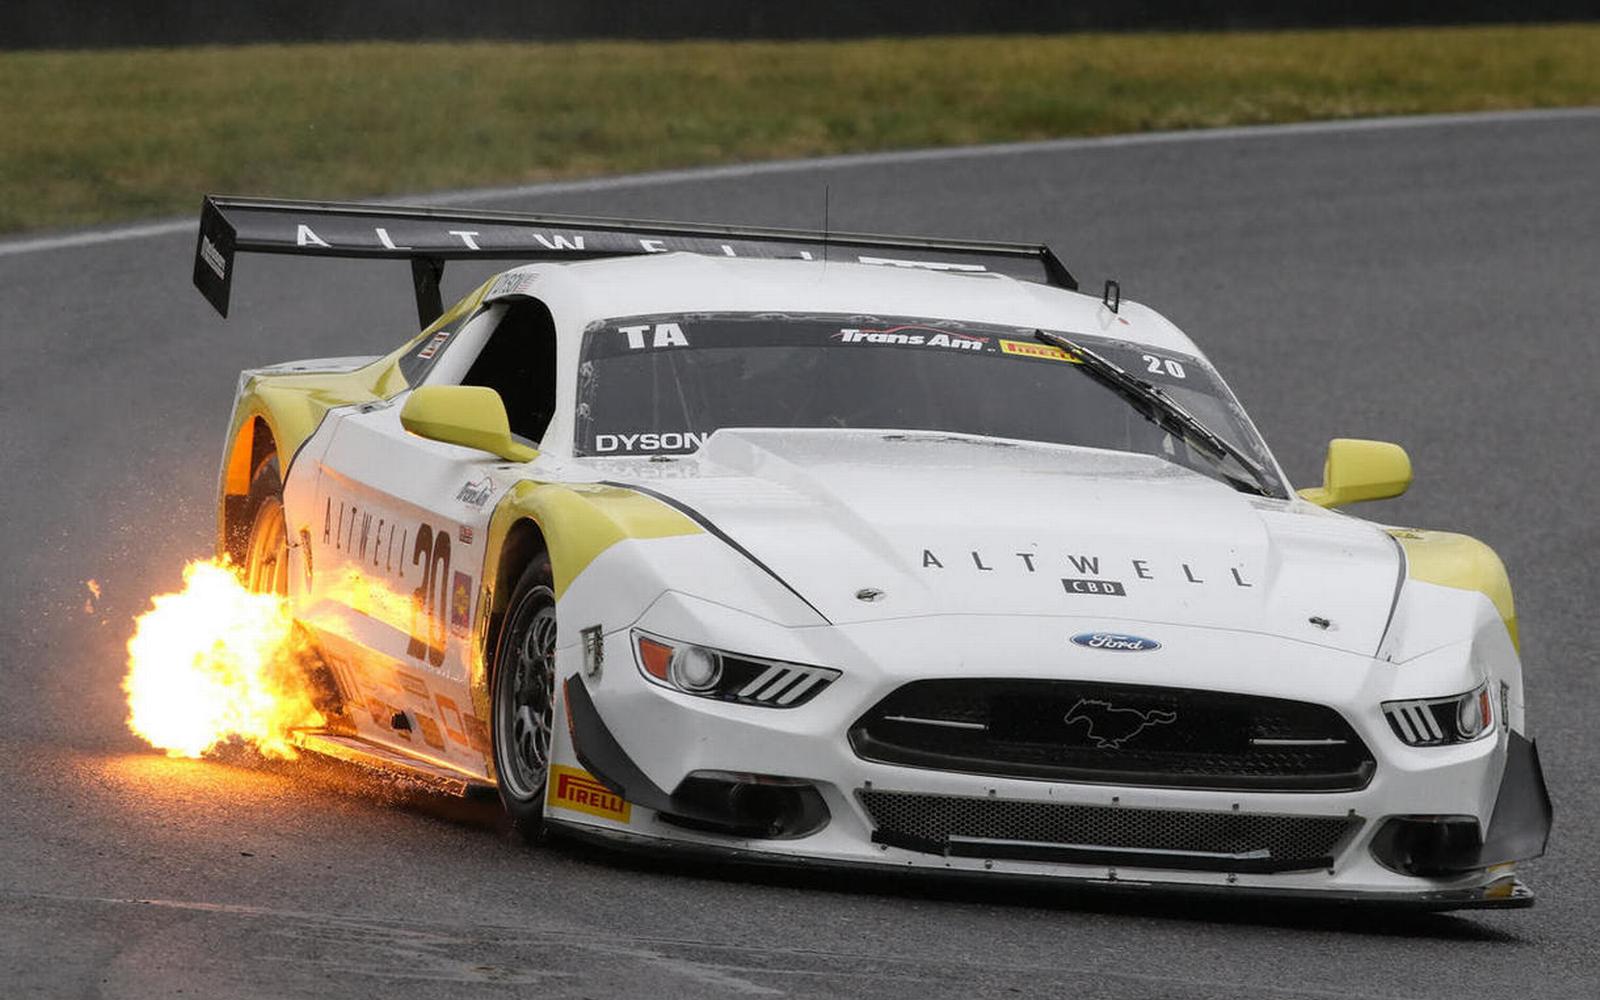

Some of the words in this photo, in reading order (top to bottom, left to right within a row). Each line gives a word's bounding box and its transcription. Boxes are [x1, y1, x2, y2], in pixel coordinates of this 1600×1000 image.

[618, 323, 689, 349] TA
[840, 328, 924, 345] Trans
[926, 333, 983, 350] Am
[1142, 354, 1186, 378] 20
[595, 432, 708, 451] DYSON
[323, 496, 408, 577] ALTWELL
[922, 549, 1253, 587] ALTWELL
[406, 522, 451, 667] 20
[1072, 581, 1116, 594] CBD
[1088, 633, 1144, 650] Ford
[557, 773, 625, 814] PIRELLI
